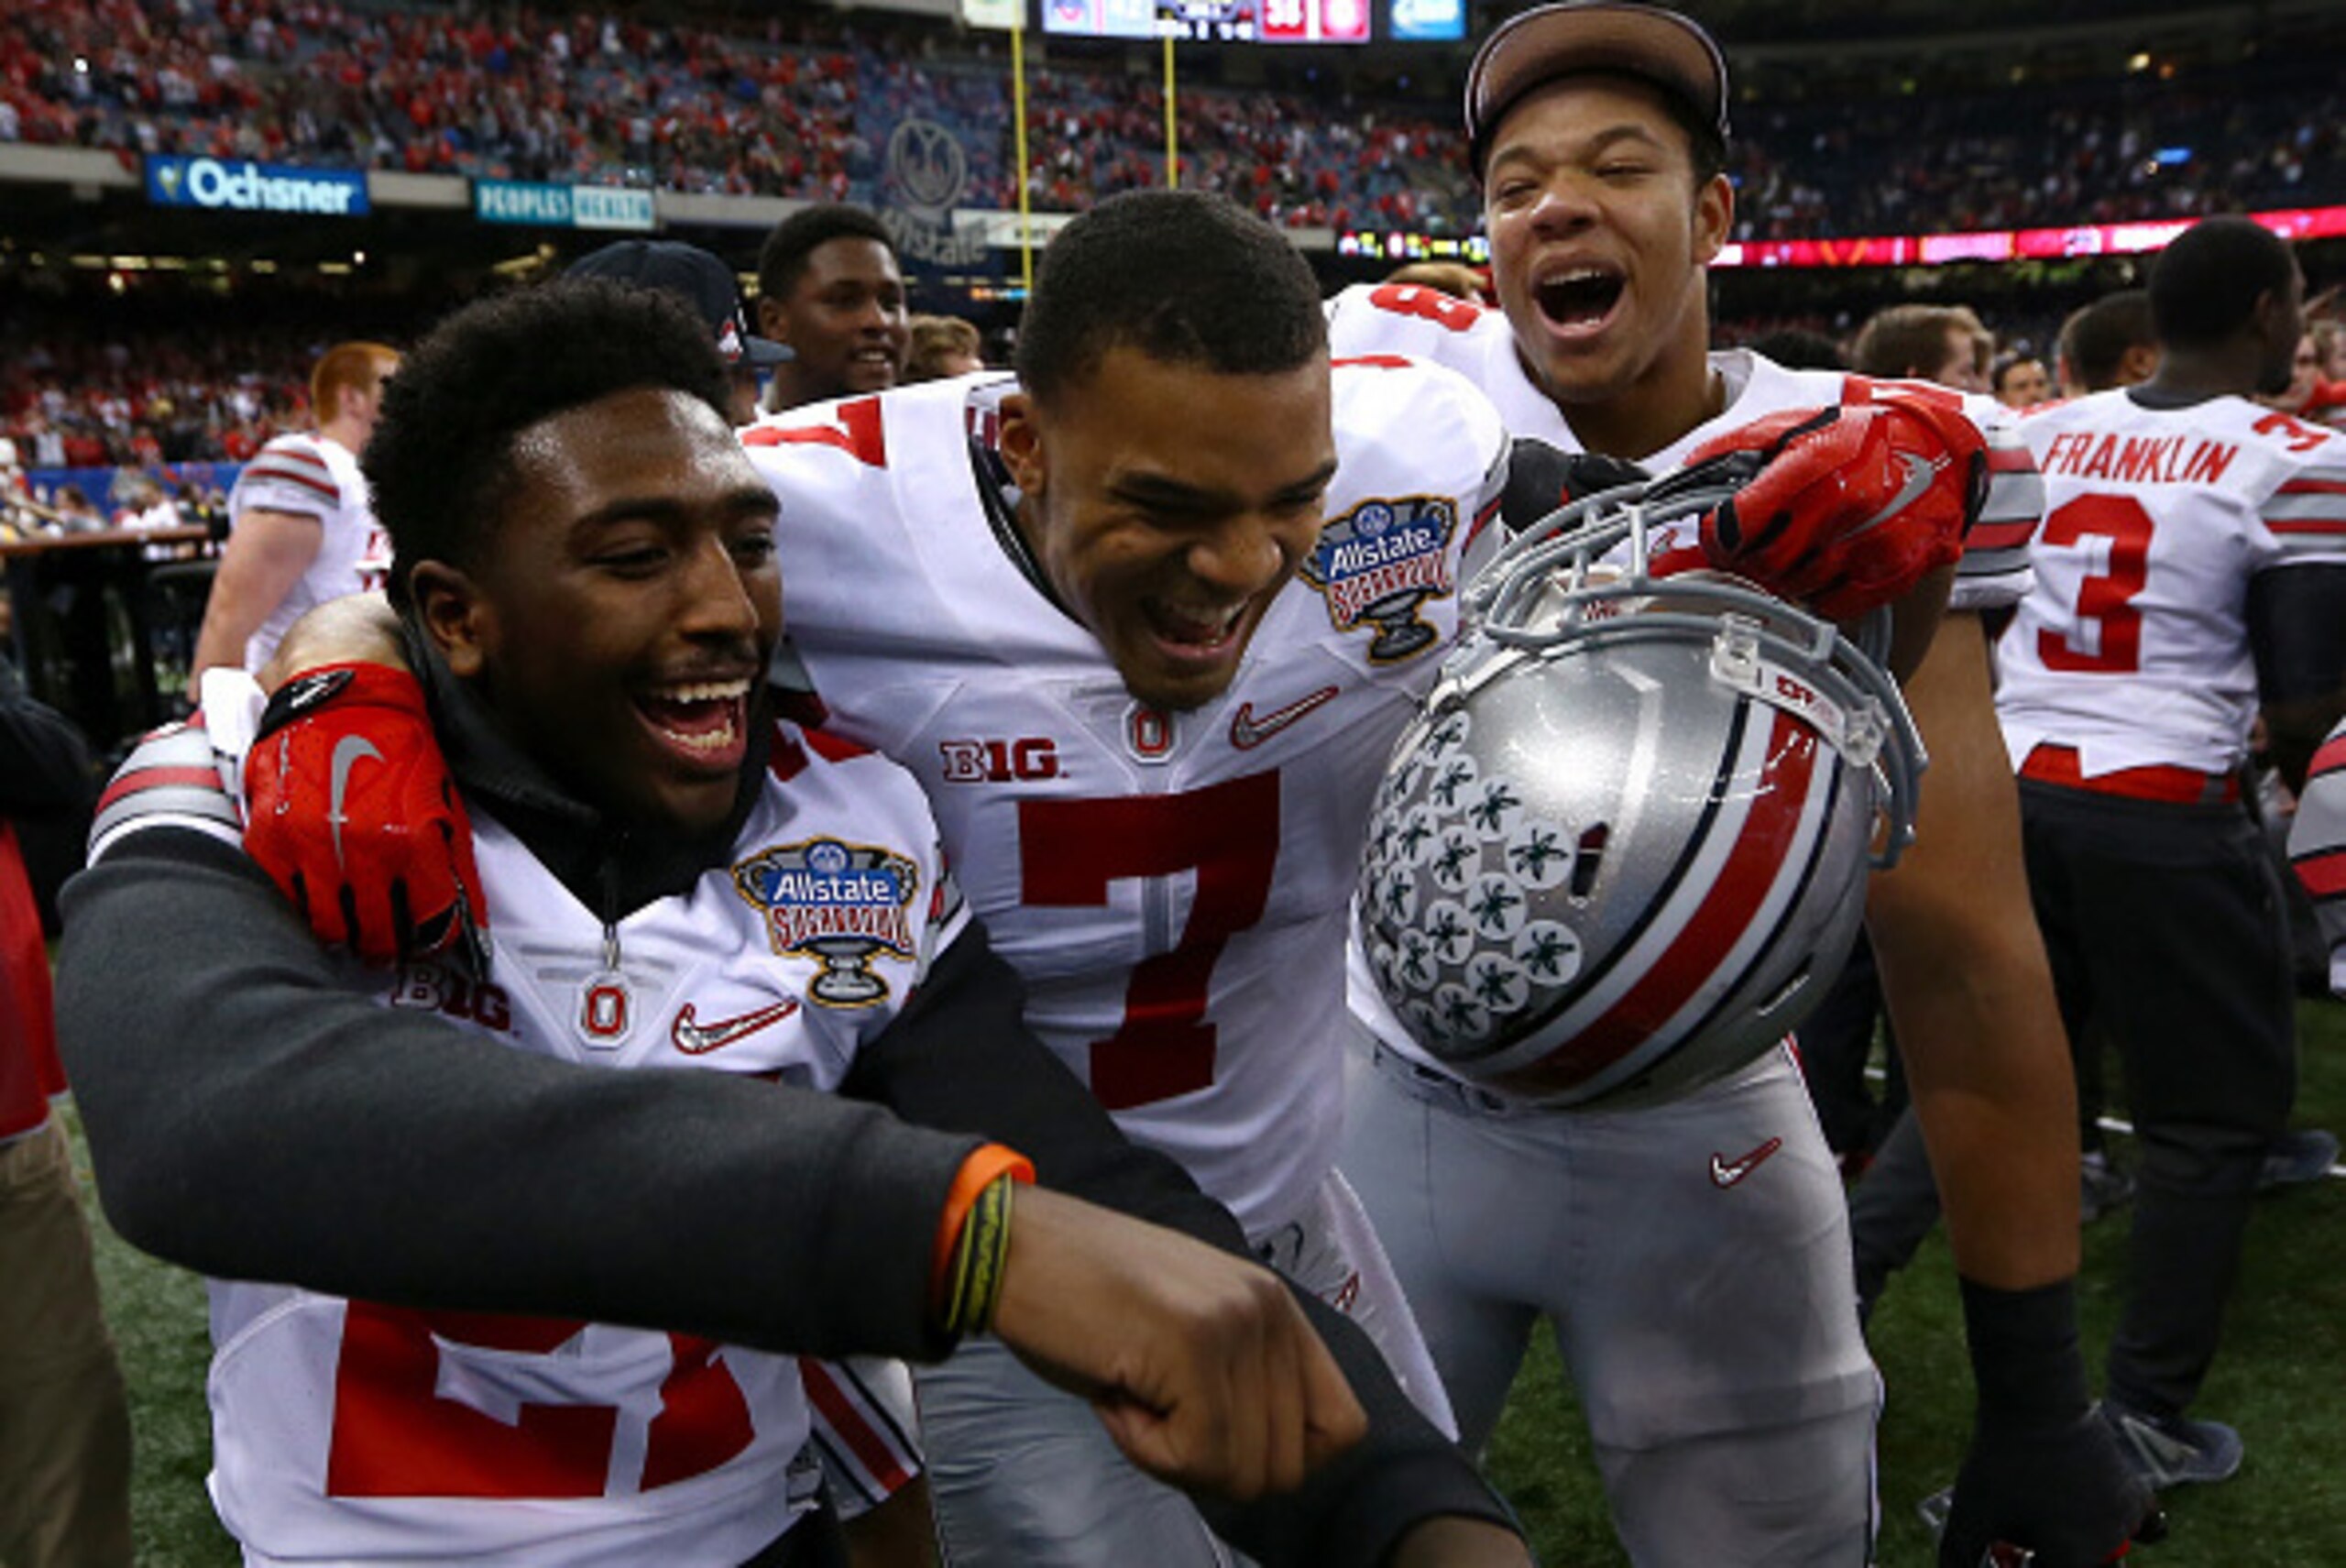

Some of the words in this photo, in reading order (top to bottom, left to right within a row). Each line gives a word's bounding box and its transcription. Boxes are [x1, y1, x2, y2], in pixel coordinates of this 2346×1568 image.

[188, 159, 351, 214] Ochsner
[2040, 432, 2241, 484] FRANKLIN
[1330, 527, 1433, 578] Allstate
[2037, 492, 2155, 674] 3
[772, 872, 893, 903] Allstate
[1017, 767, 1281, 1112] 7
[579, 978, 630, 1040] O
